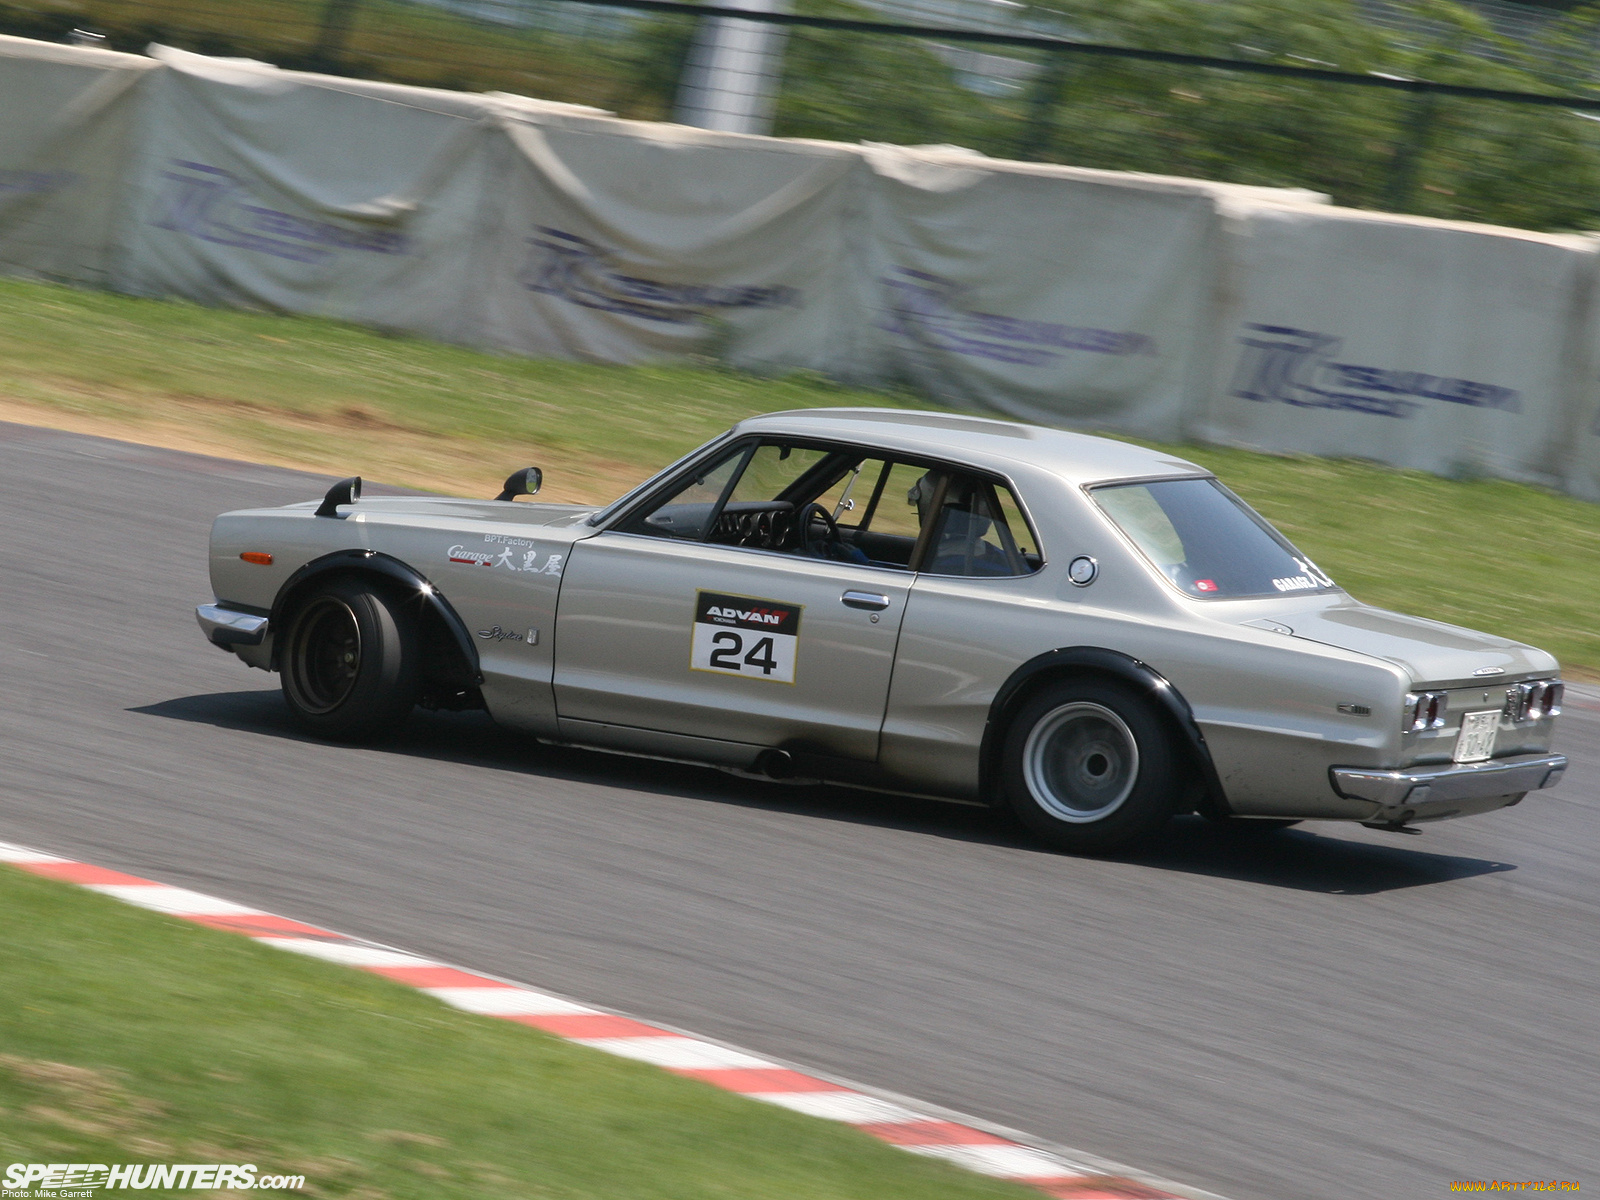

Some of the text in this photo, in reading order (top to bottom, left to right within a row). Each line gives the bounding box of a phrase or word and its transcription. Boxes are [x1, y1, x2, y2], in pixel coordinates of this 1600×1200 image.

[484, 534, 534, 548] BPT.Factory
[447, 544, 494, 566] Garage
[706, 606, 780, 625] ADVAN
[709, 631, 777, 675] 24
